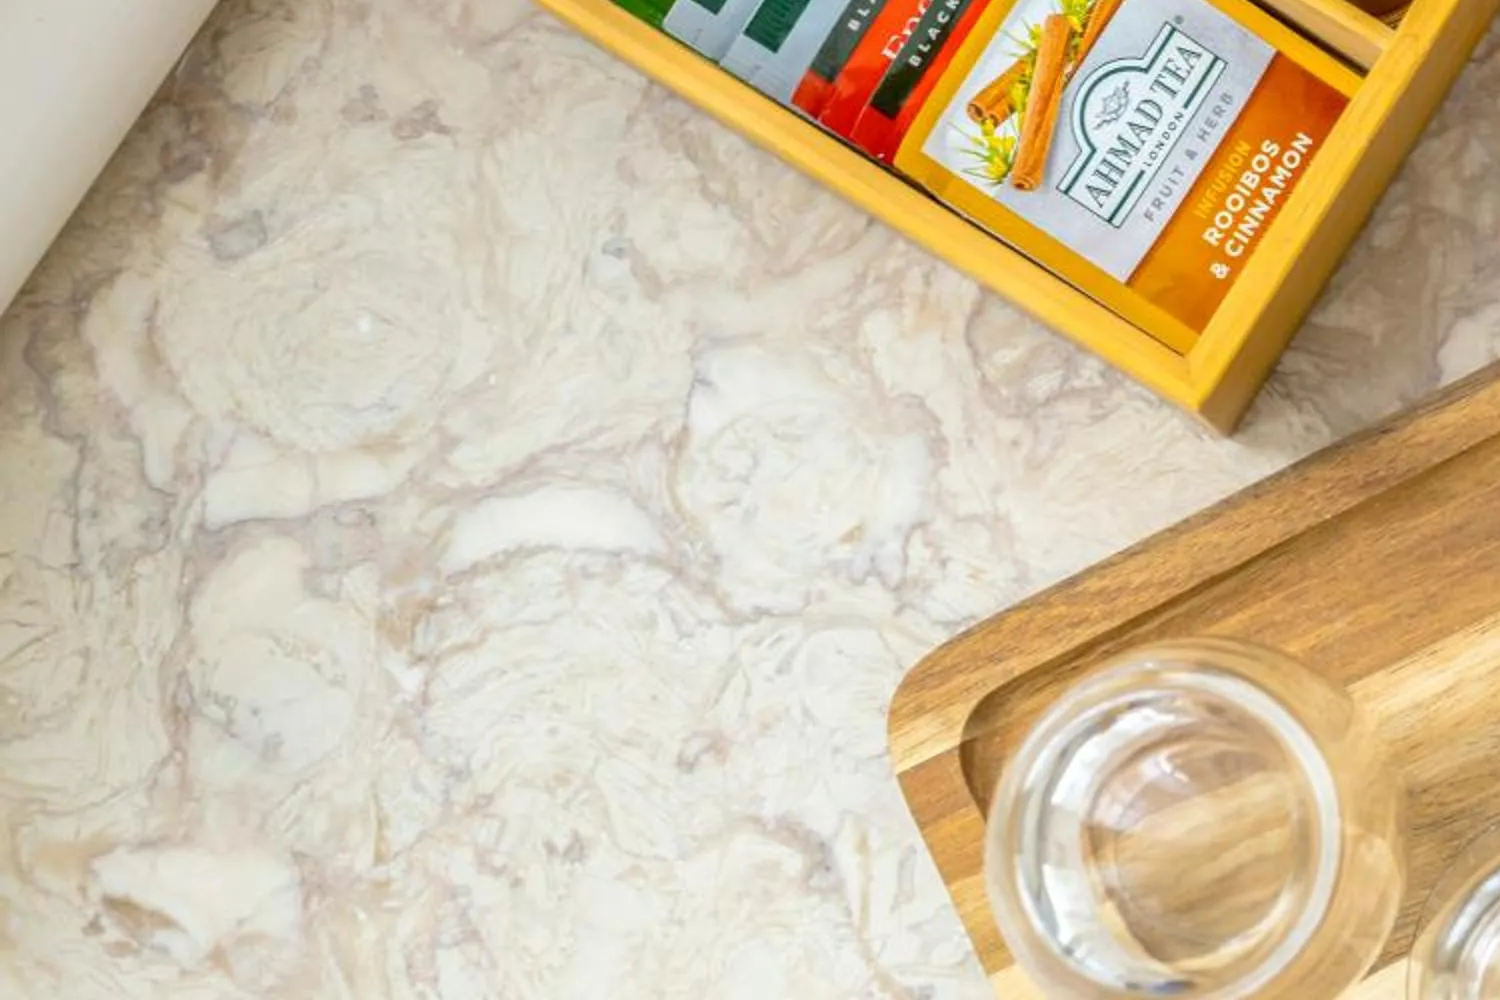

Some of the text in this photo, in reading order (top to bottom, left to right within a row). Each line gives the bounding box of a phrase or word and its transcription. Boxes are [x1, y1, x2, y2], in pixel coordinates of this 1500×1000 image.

[1085, 45, 1203, 209] AHMAD TEA
[1143, 110, 1185, 168] LONDON
[1143, 165, 1186, 222] FRUIT
[1196, 92, 1234, 144] HERB
[1193, 139, 1252, 218] INFUSION
[1202, 139, 1281, 247] ROOIBOS
[1209, 131, 1314, 279] & CINNAMON
